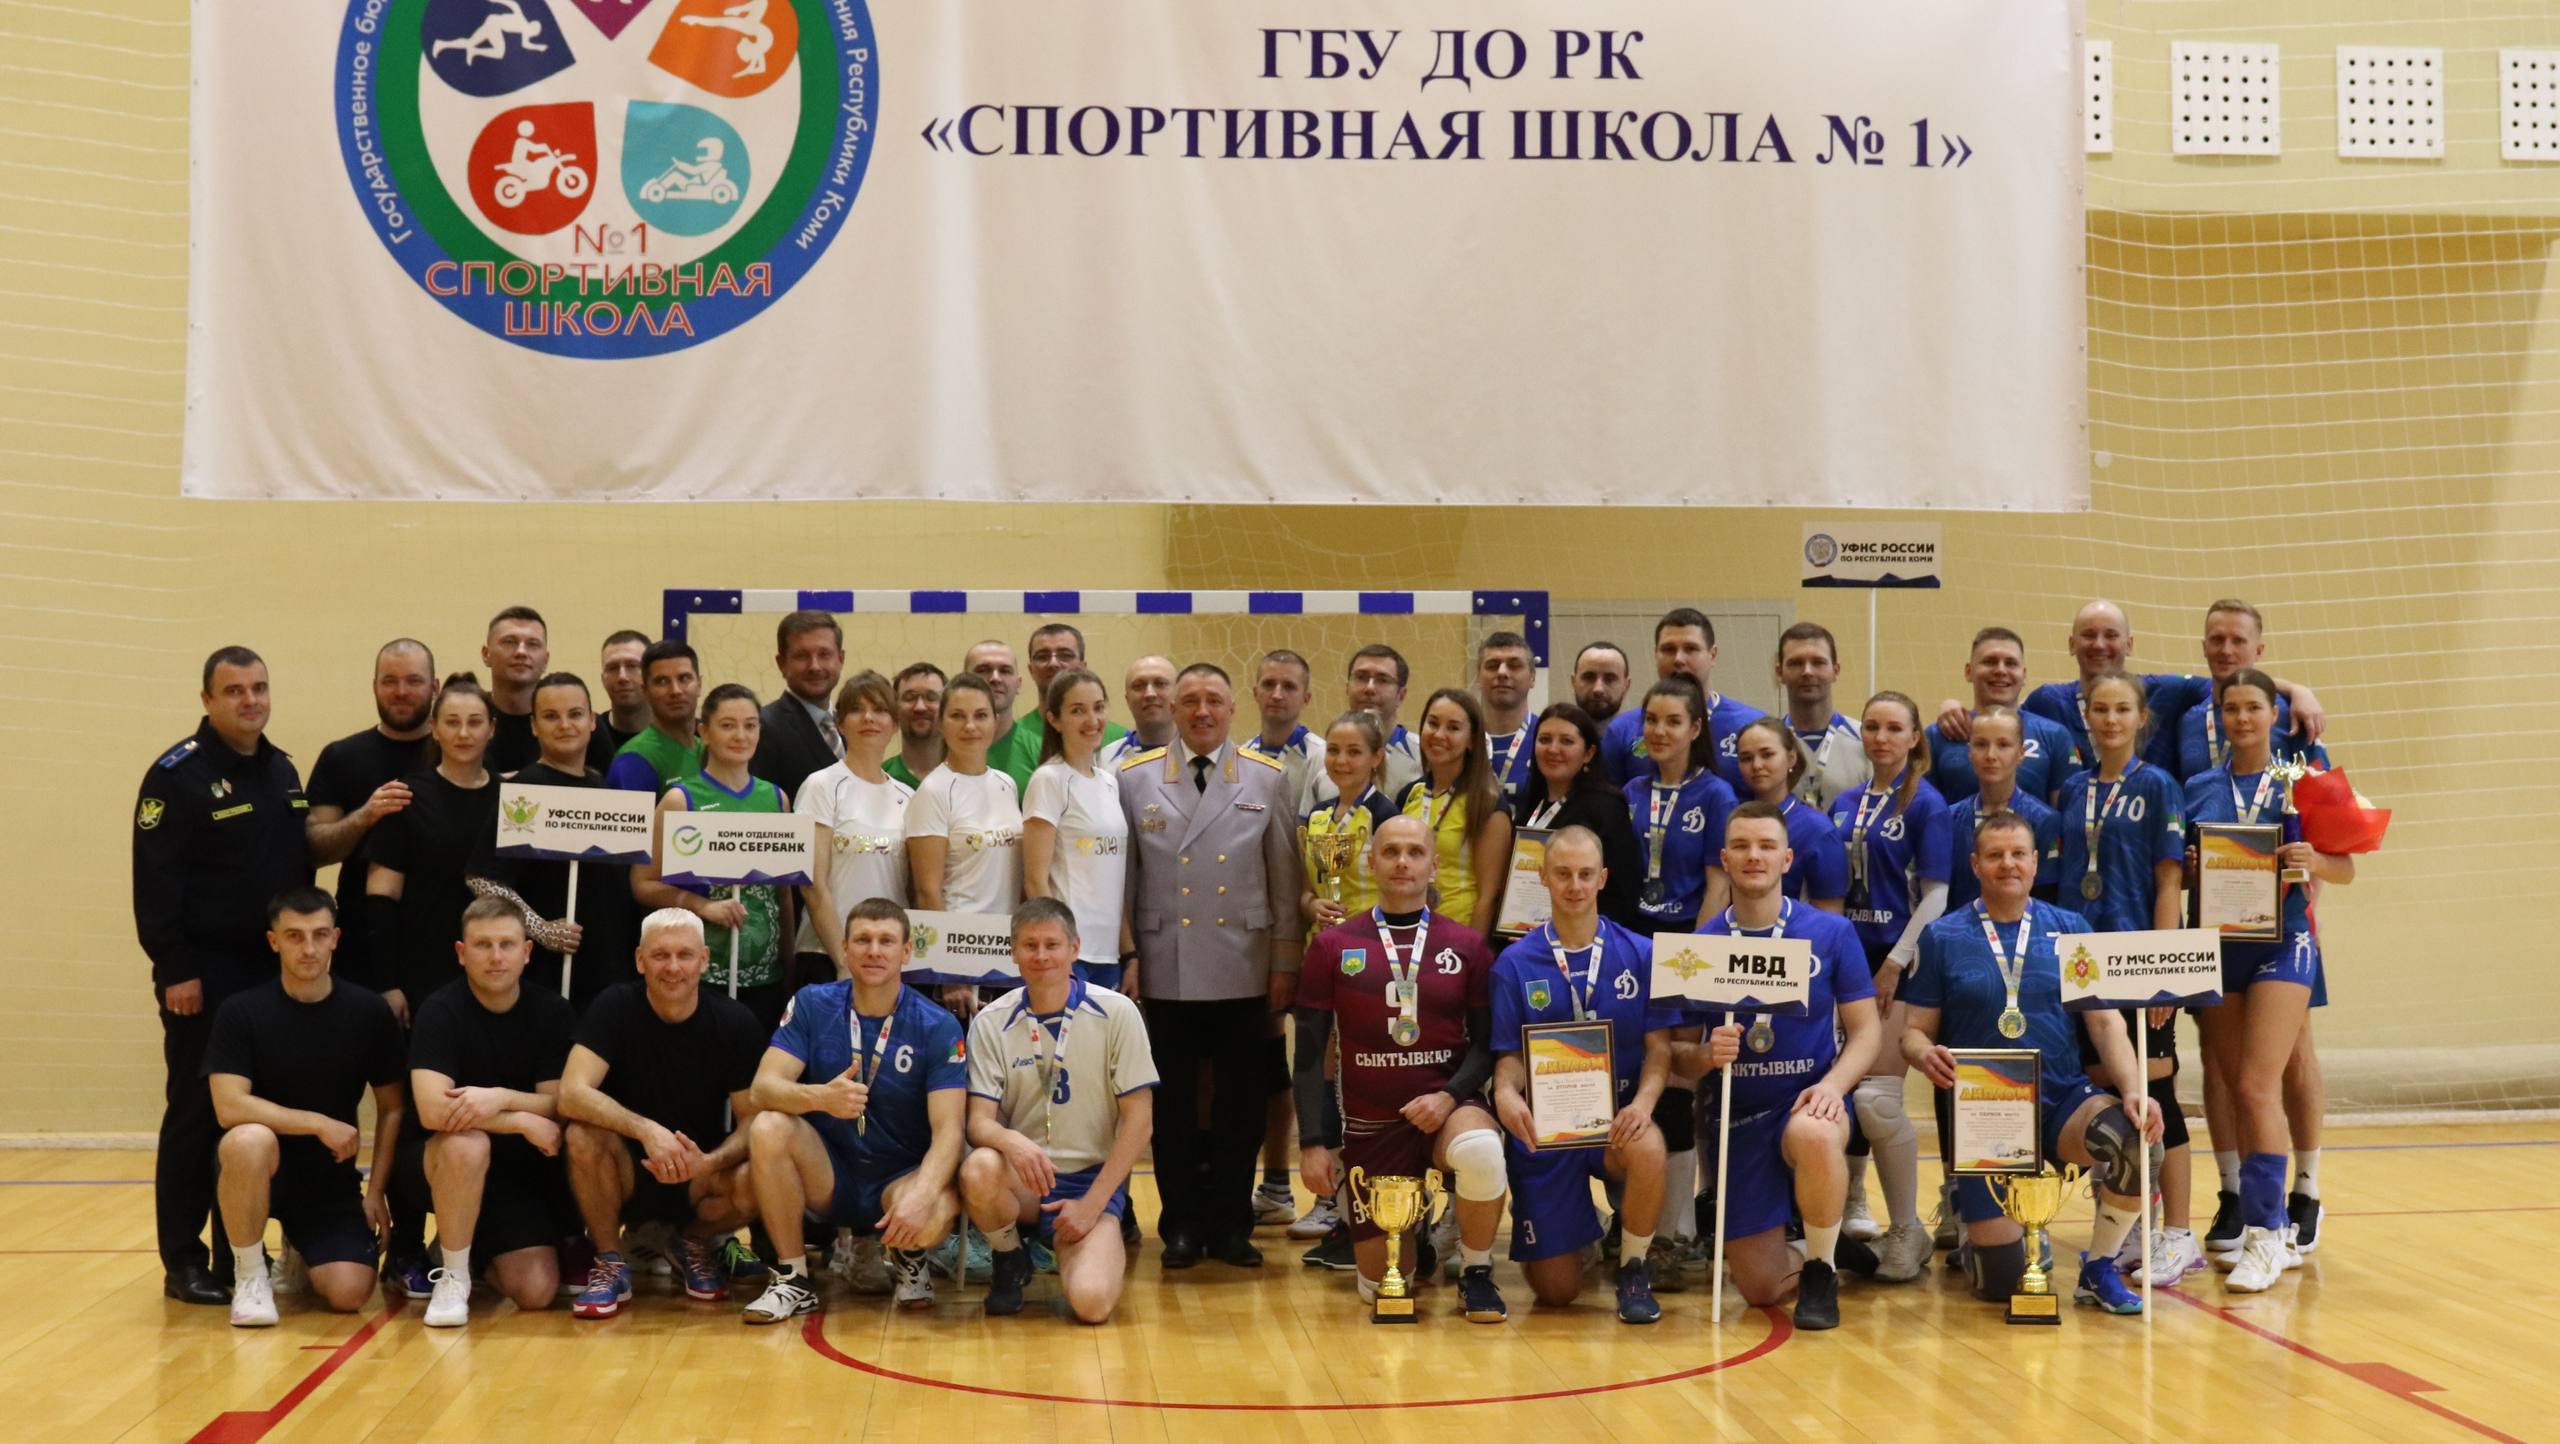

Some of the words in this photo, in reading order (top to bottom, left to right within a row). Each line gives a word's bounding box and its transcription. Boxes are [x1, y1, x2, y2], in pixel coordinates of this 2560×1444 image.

[1258, 28, 1402, 79] ГБУ
[1420, 28, 1527, 93] ДО
[1549, 29, 1644, 80] РК
[842, 48, 868, 186] Республики
[352, 41, 412, 244] Государственное
[920, 104, 1486, 160] «СПОРТИВНАЯ
[1508, 110, 1797, 163] ШКОЛА
[1816, 114, 1885, 166] №
[1908, 117, 1974, 168] 1»
[796, 190, 845, 250] Коми
[425, 261, 772, 297] СПОРТИВНАЯ
[504, 302, 695, 336] ШКОЛА
[1841, 543, 1877, 553] УФНС
[1881, 543, 1935, 553] РОССИИ
[547, 808, 592, 821] УФССП
[594, 810, 646, 824] РОССИИ
[2114, 794, 2146, 823] 10
[545, 821, 559, 829] ПО
[560, 822, 618, 832] РЕСПУБЛИКЕ
[620, 825, 647, 833] КОМИ
[717, 830, 742, 839] КОМИ
[745, 831, 795, 839] ОТДЕЛЕНИЕ
[708, 841, 736, 852] ПАО
[738, 841, 805, 853] СБЕРБАНК
[947, 933, 1011, 946] ПРОКУРА
[946, 946, 1011, 956] РЕСПУБЛИКИ
[2107, 955, 2123, 966] ГУ
[2126, 954, 2156, 965] МЧС
[2159, 952, 2215, 964] РОССИИ
[1728, 954, 1786, 978] МВД
[2124, 967, 2185, 976] РЕСПУБЛИКЕ
[2188, 965, 2217, 973] КОМИ
[1727, 978, 1774, 987] РЕСПУБЛИКЕ
[894, 1045, 914, 1073] 6
[1355, 1049, 1452, 1067] СЫКТЫВКАР
[1722, 1058, 1815, 1077] ЫКТЫВКАР
[1523, 1220, 1536, 1244] 3
